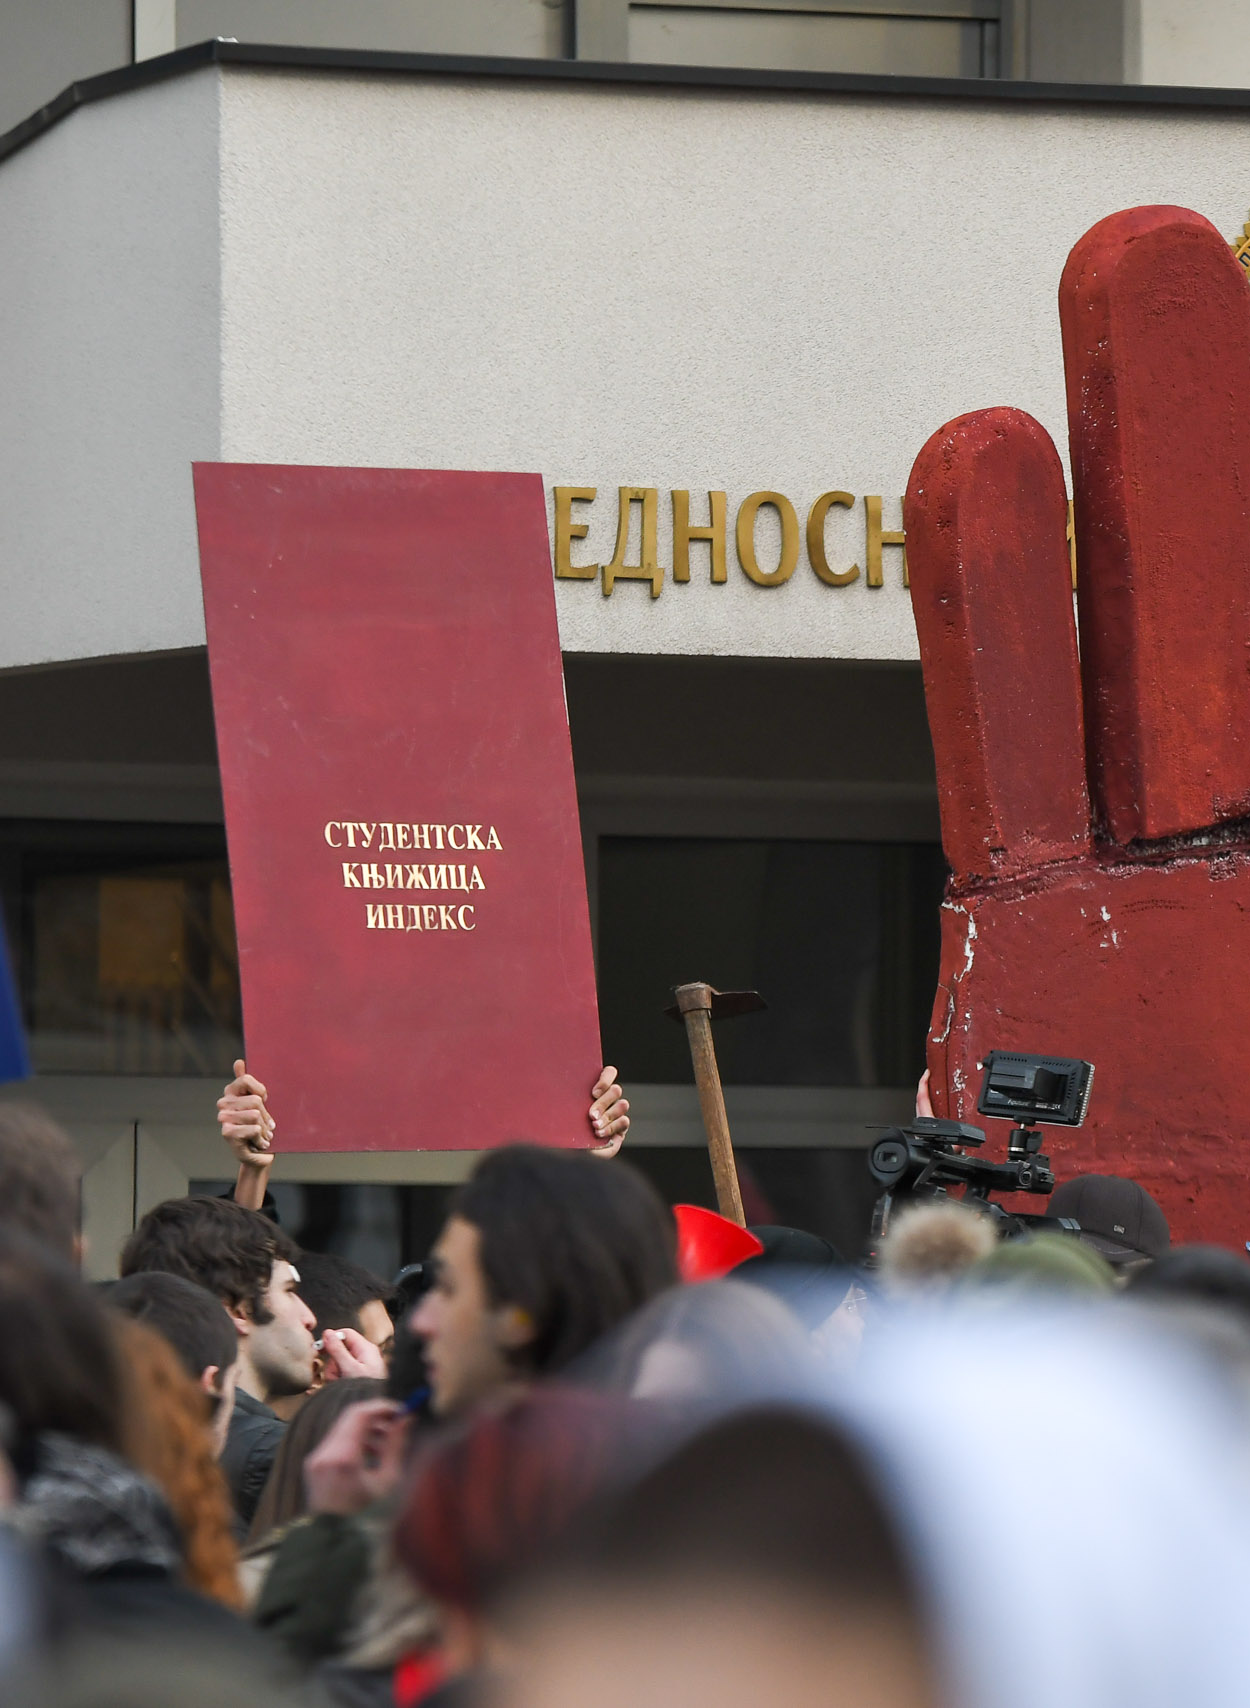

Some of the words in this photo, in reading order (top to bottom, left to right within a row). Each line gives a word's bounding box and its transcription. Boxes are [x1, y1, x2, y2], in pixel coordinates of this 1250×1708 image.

[553, 486, 910, 599] ЕДНОСН
[324, 821, 504, 852] СТУДЕНТСКА
[342, 862, 486, 894] КЊИЖИЦА
[365, 904, 476, 932] ИНДЕКС
